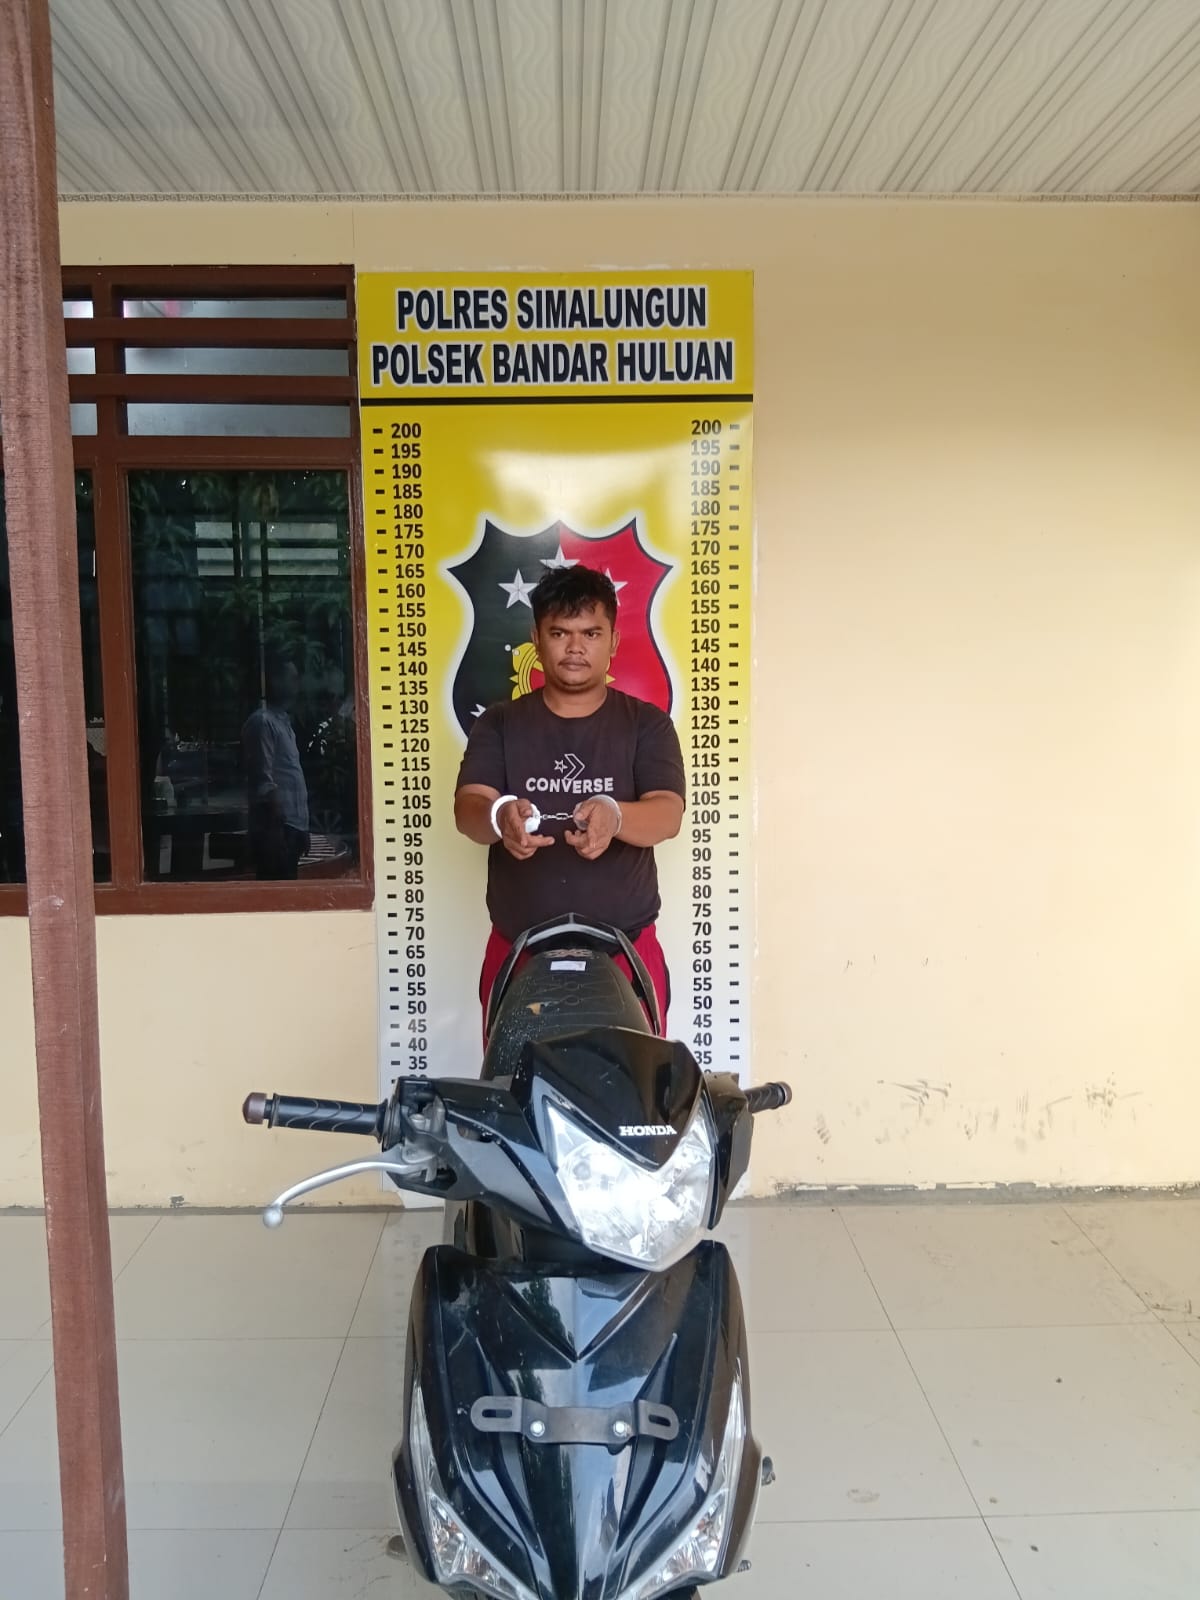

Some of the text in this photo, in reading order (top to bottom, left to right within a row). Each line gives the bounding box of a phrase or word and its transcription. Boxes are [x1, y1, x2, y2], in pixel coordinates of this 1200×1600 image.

[397, 286, 707, 330] POLRES SIMALUNGUN
[371, 340, 734, 385] POLSEK BANDAR HULUAN
[391, 423, 421, 438] 200
[691, 419, 721, 435] 200
[392, 443, 420, 458] 195
[692, 440, 720, 455] 195
[393, 464, 421, 479] 190
[692, 460, 720, 475] 190
[393, 484, 422, 499] 185
[692, 480, 720, 496] 185
[394, 504, 423, 519] 180
[692, 500, 720, 515] 180
[395, 524, 423, 539] 175
[692, 520, 720, 535] 175
[395, 544, 424, 559] 170
[692, 540, 720, 555] 170
[396, 564, 424, 578] 165
[692, 560, 720, 575] 165
[397, 584, 425, 598] 160
[692, 580, 720, 594] 160
[397, 603, 425, 617] 155
[692, 600, 720, 614] 155
[398, 623, 426, 637] 150
[692, 619, 720, 633] 150
[398, 642, 426, 656] 145
[692, 638, 719, 653] 145
[399, 661, 427, 676] 140
[692, 658, 720, 672] 140
[400, 681, 428, 695] 135
[692, 677, 719, 691] 135
[400, 700, 428, 714] 130
[692, 696, 720, 710] 130
[401, 719, 429, 733] 125
[692, 715, 719, 729] 125
[401, 738, 429, 752] 120
[692, 735, 720, 748] 120
[402, 757, 430, 771] 115
[692, 753, 720, 767] 115
[402, 776, 430, 790] 110
[525, 777, 614, 794] CONVERSE
[692, 772, 720, 786] 110
[403, 795, 431, 809] 105
[692, 791, 720, 805] 105
[403, 814, 431, 828] 100
[692, 810, 720, 824] 100
[404, 833, 422, 847] 95
[692, 829, 711, 843] 95
[404, 852, 423, 865] 90
[693, 848, 711, 861] 90
[405, 871, 423, 884] 85
[693, 866, 711, 880] 85
[405, 889, 424, 903] 80
[693, 885, 711, 899] 80
[405, 908, 424, 921] 75
[693, 904, 711, 917] 75
[406, 927, 424, 940] 70
[693, 922, 711, 935] 70
[406, 945, 425, 959] 65
[693, 941, 711, 954] 65
[407, 964, 425, 977] 60
[693, 959, 711, 973] 60
[408, 982, 426, 996] 55
[694, 977, 712, 991] 55
[408, 1001, 426, 1014] 50
[694, 996, 712, 1009] 50
[408, 1019, 426, 1033] 45
[693, 1014, 712, 1028] 45
[408, 1038, 427, 1051] 40
[693, 1033, 712, 1046] 40
[409, 1056, 427, 1070] 35
[694, 1051, 712, 1065] 35
[618, 1124, 678, 1137] HONDA
